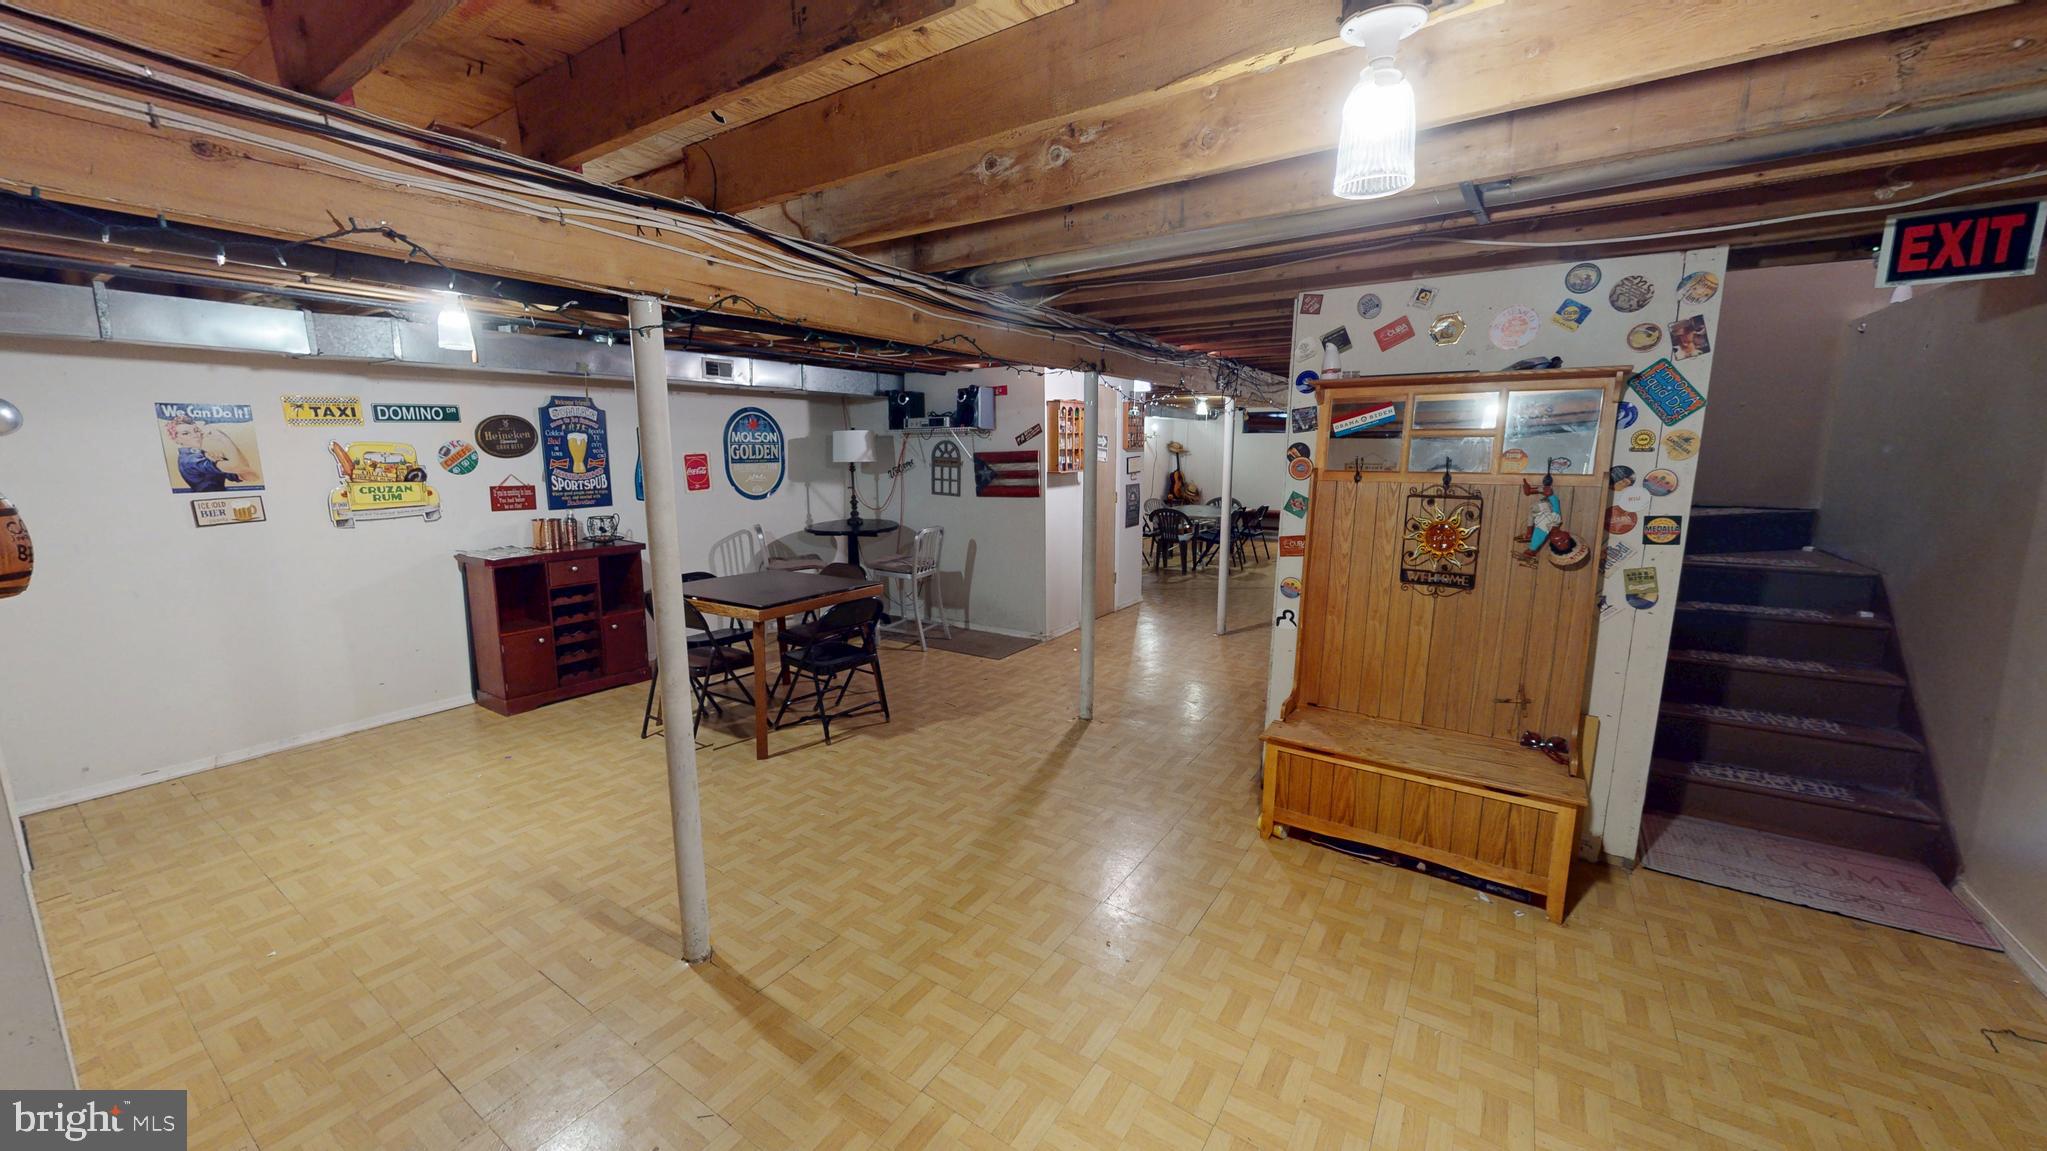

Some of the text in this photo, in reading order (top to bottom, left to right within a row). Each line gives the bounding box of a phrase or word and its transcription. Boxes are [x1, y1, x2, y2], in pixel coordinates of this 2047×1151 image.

[1896, 213, 2027, 273] EXIT
[161, 404, 250, 419] We Can Do It!
[309, 406, 357, 418] TAXI
[376, 406, 443, 420] DOMINO
[1334, 420, 1360, 430] OBAMA
[1369, 409, 1394, 420] BIDEN
[484, 430, 531, 441] Heineken
[731, 431, 778, 442] MOLSON
[731, 444, 779, 459] GOLDEN
[359, 485, 413, 494] CRUZAN
[372, 493, 403, 502] RUM
[198, 502, 211, 510] ICE
[200, 509, 226, 518] BIER
[1407, 572, 1470, 586] WELCOME
